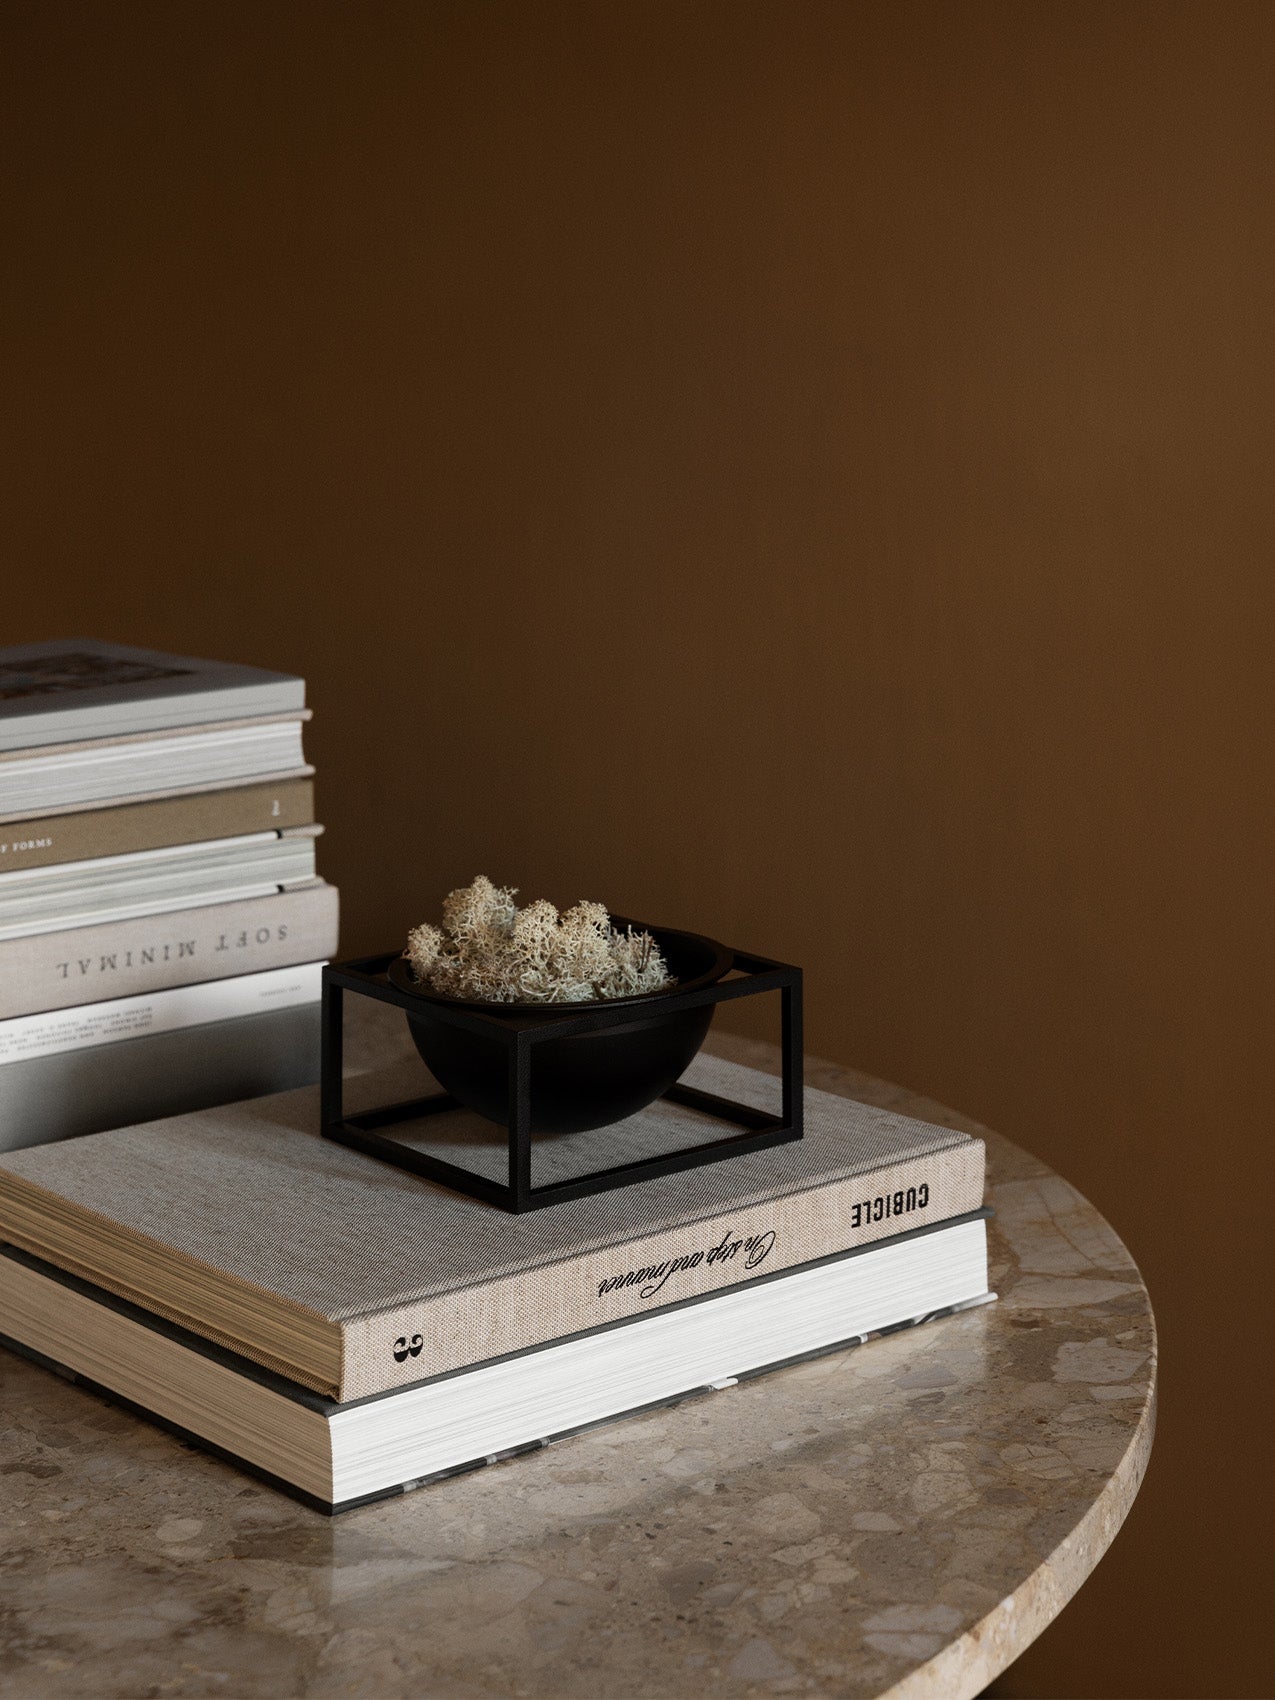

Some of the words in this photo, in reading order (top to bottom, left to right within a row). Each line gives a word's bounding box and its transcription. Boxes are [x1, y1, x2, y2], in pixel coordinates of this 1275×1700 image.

[0, 843, 8, 854] F
[12, 836, 53, 852] FORMS
[215, 924, 289, 951] SOFT
[56, 940, 197, 978] MINIMAL
[851, 1183, 929, 1228] CUBICLE
[706, 1230, 743, 1266] step
[744, 1230, 776, 1270] On
[598, 1260, 670, 1298] manner
[640, 1250, 704, 1298] and
